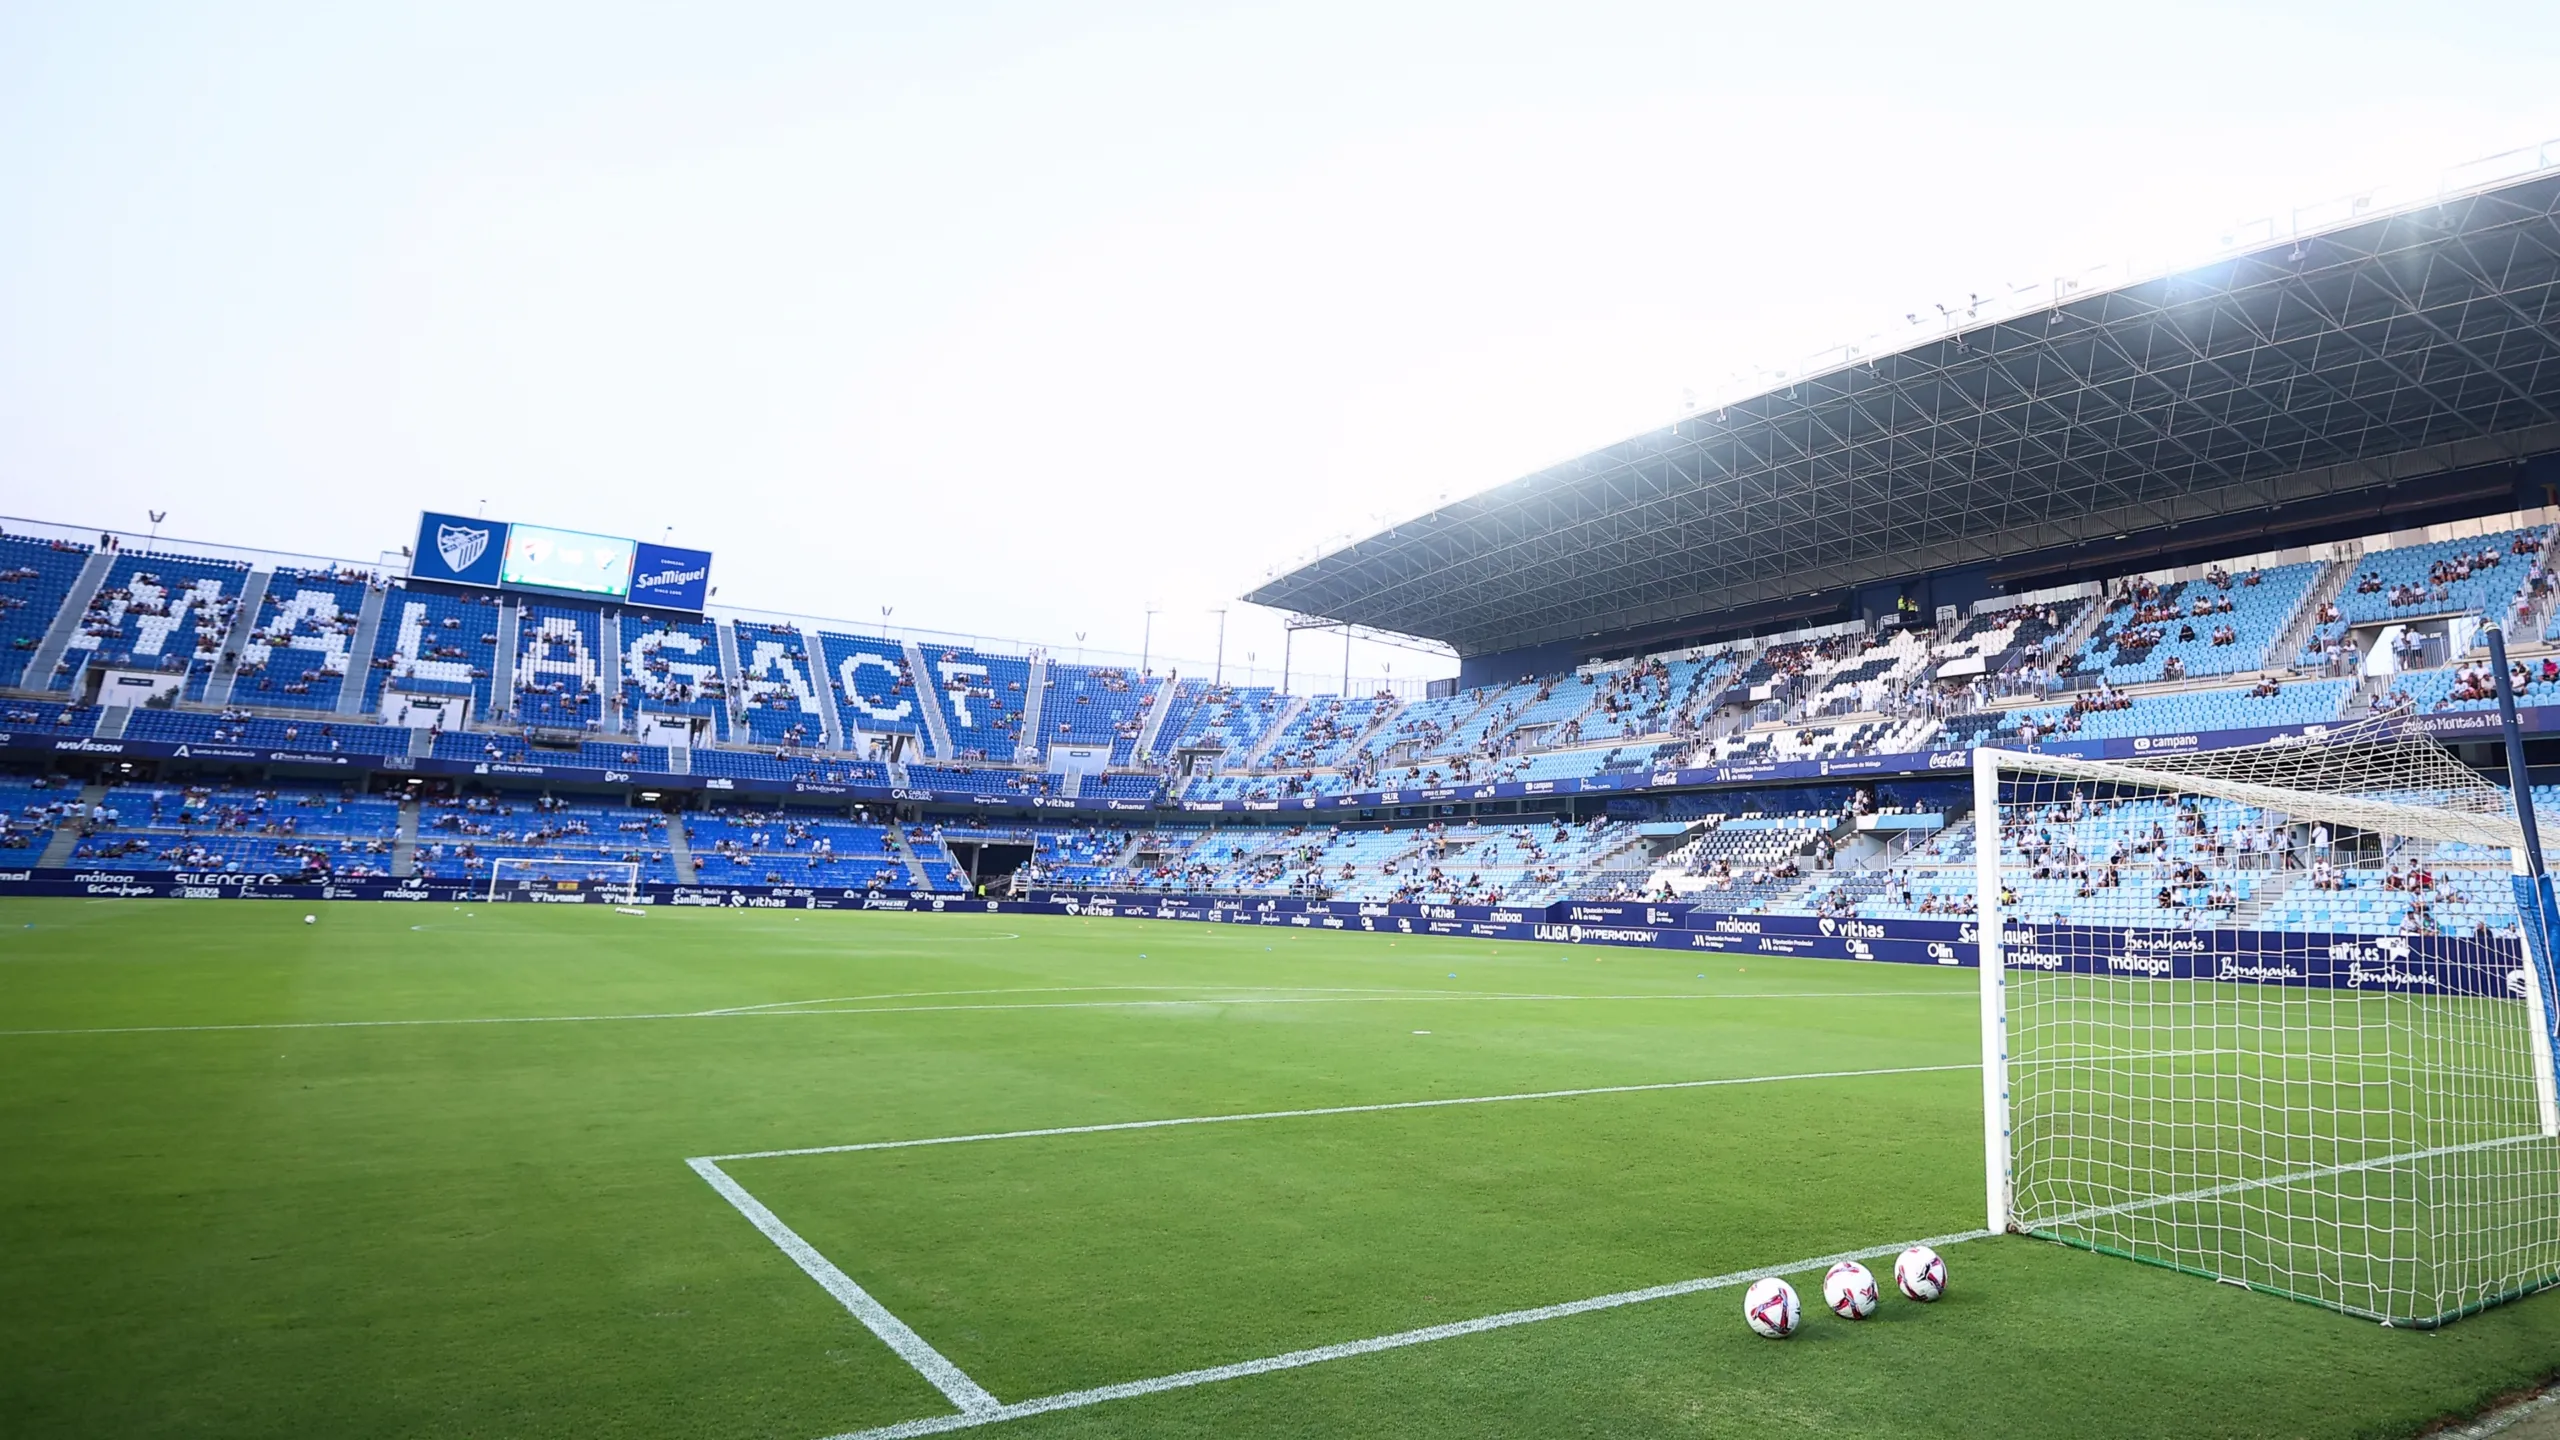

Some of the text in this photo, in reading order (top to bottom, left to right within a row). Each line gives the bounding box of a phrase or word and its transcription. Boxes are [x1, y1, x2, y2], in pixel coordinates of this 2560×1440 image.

[636, 567, 706, 588] SanMiguel
[2152, 734, 2198, 748] campano
[1382, 792, 1398, 800] SUR
[1046, 799, 1075, 808] vithas
[1192, 802, 1224, 811] hummel
[174, 874, 256, 884] SILENCE
[543, 892, 586, 902] hummel
[748, 896, 786, 908] vithas
[1080, 905, 1114, 916] vithas
[1431, 906, 1456, 918] vithas
[1534, 924, 1568, 941] LALIGA
[1838, 921, 1885, 938] vithas
